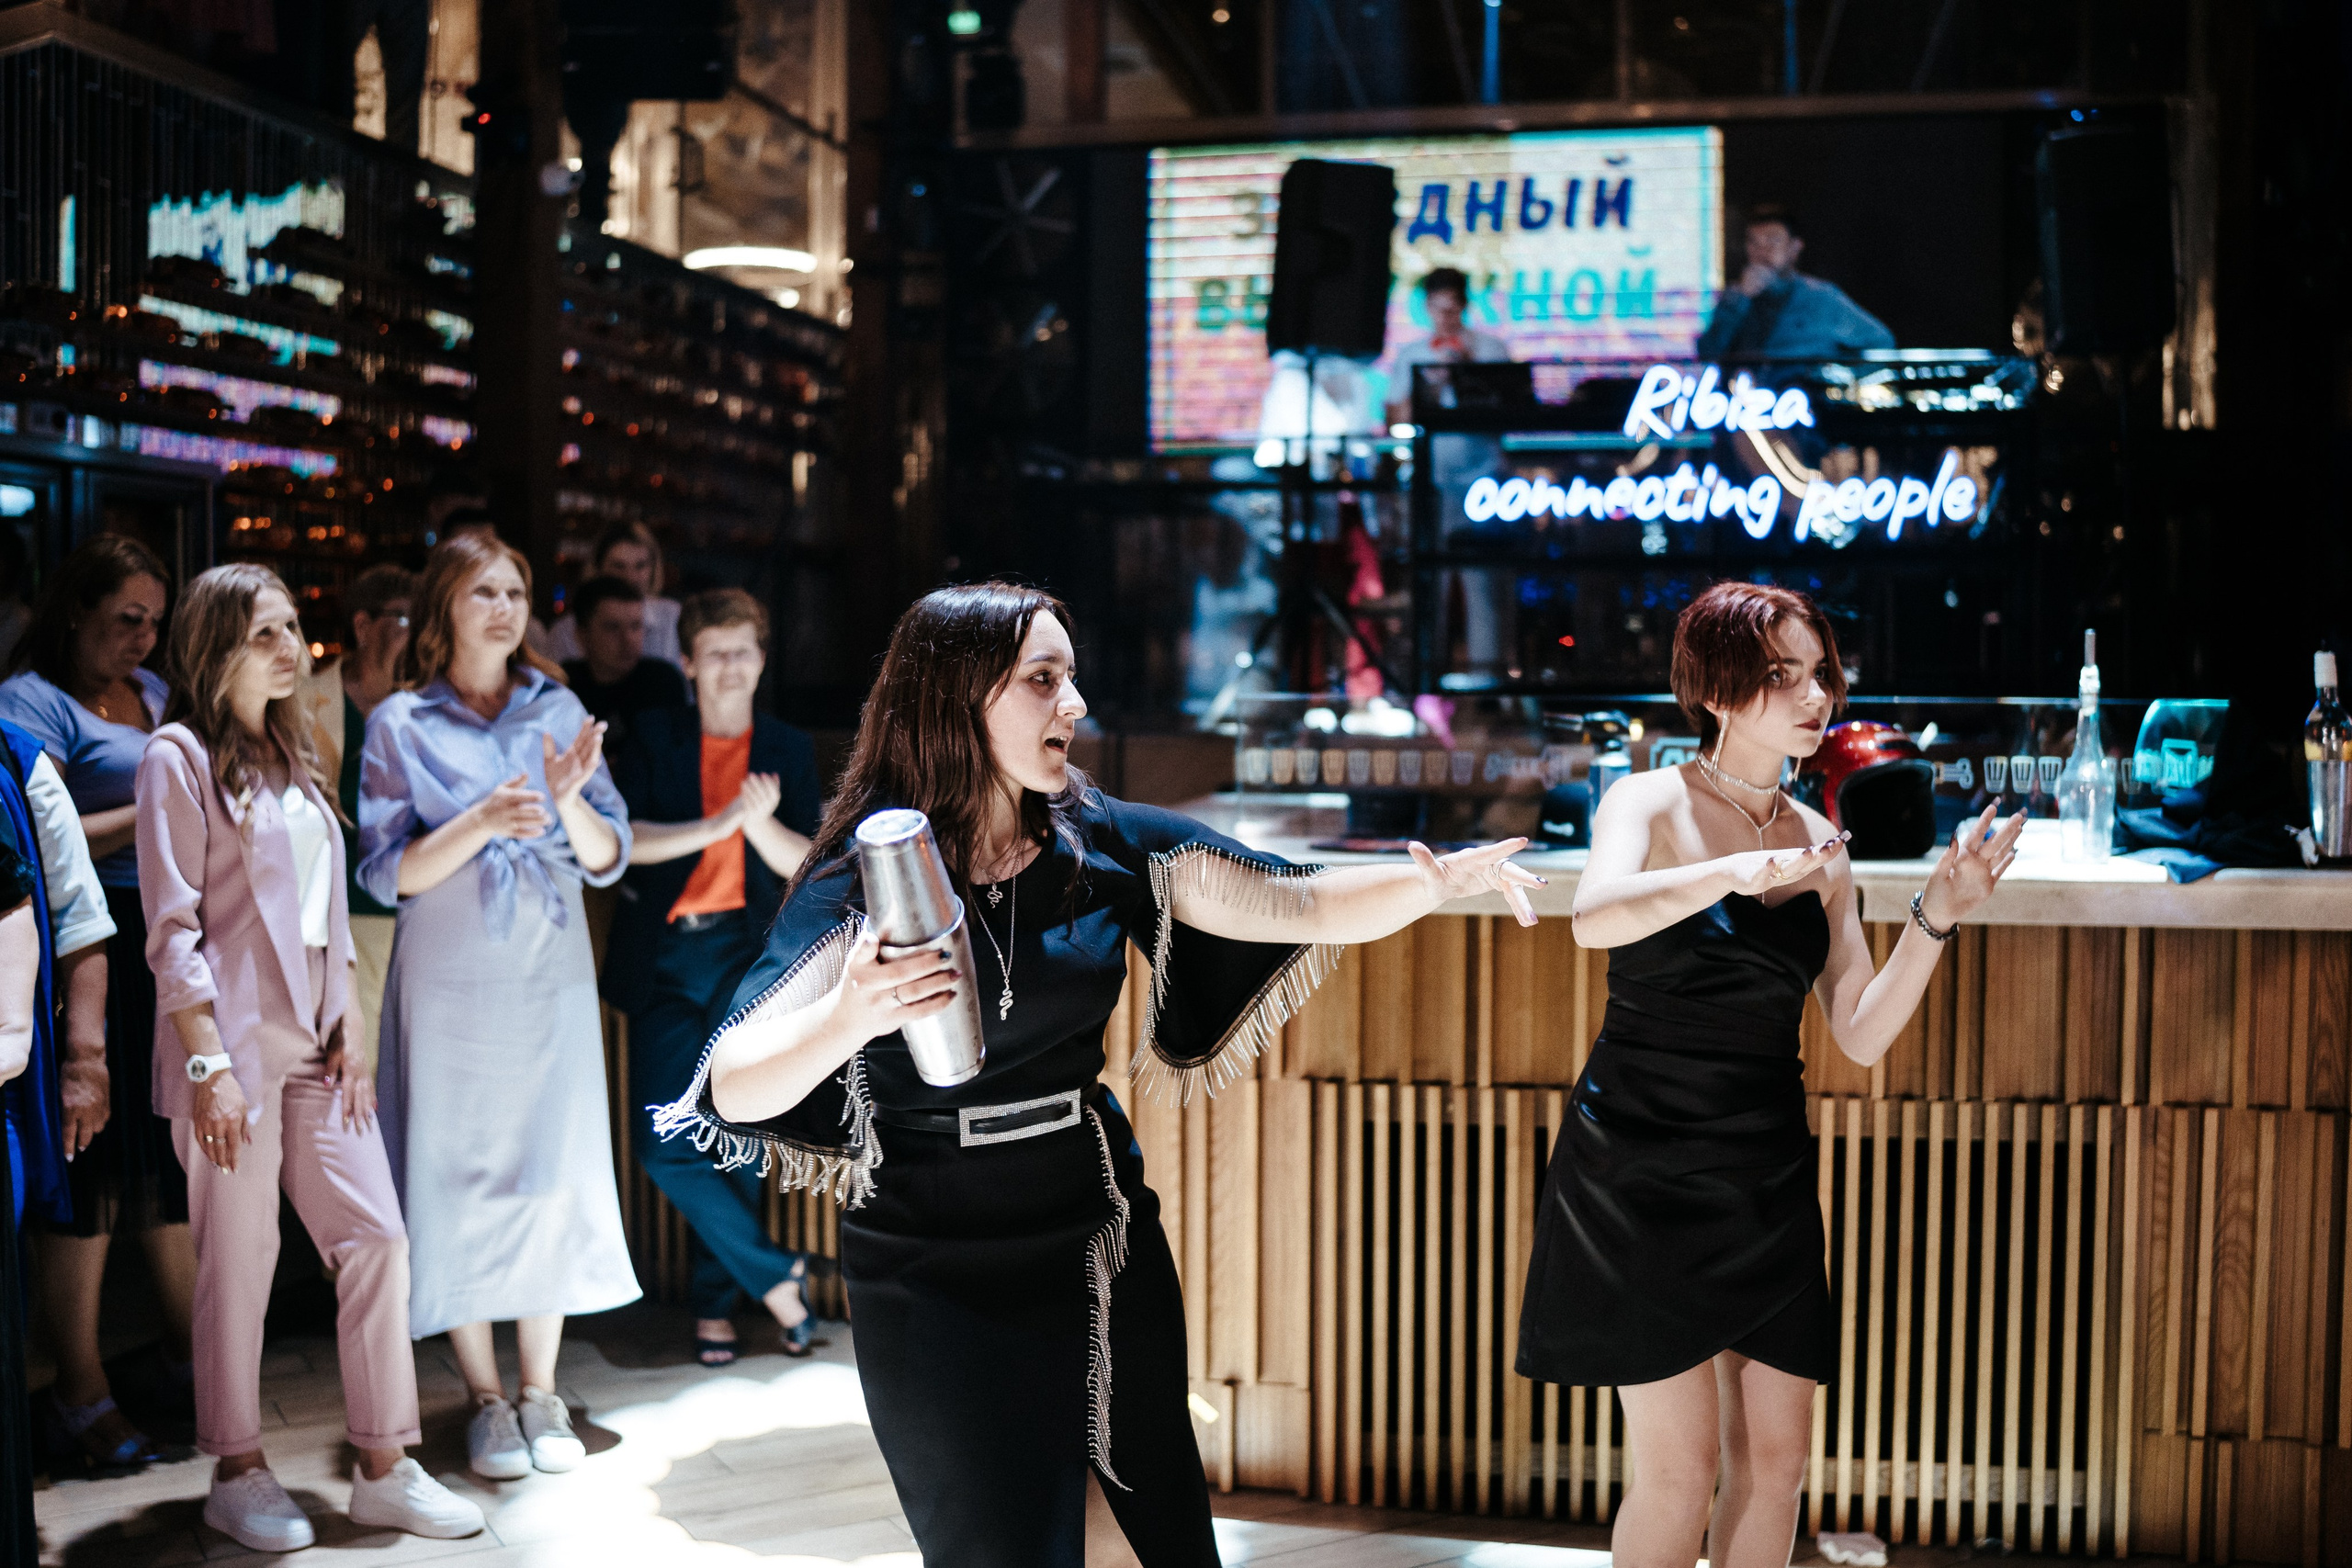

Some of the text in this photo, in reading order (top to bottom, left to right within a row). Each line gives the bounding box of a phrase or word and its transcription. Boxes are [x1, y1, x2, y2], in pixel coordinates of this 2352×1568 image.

[1231, 154, 1634, 245] ЗДНЫЙ
[1195, 245, 1657, 331] ВКНОЙ
[1624, 365, 1815, 439] Ribiza
[1795, 448, 1977, 542] people
